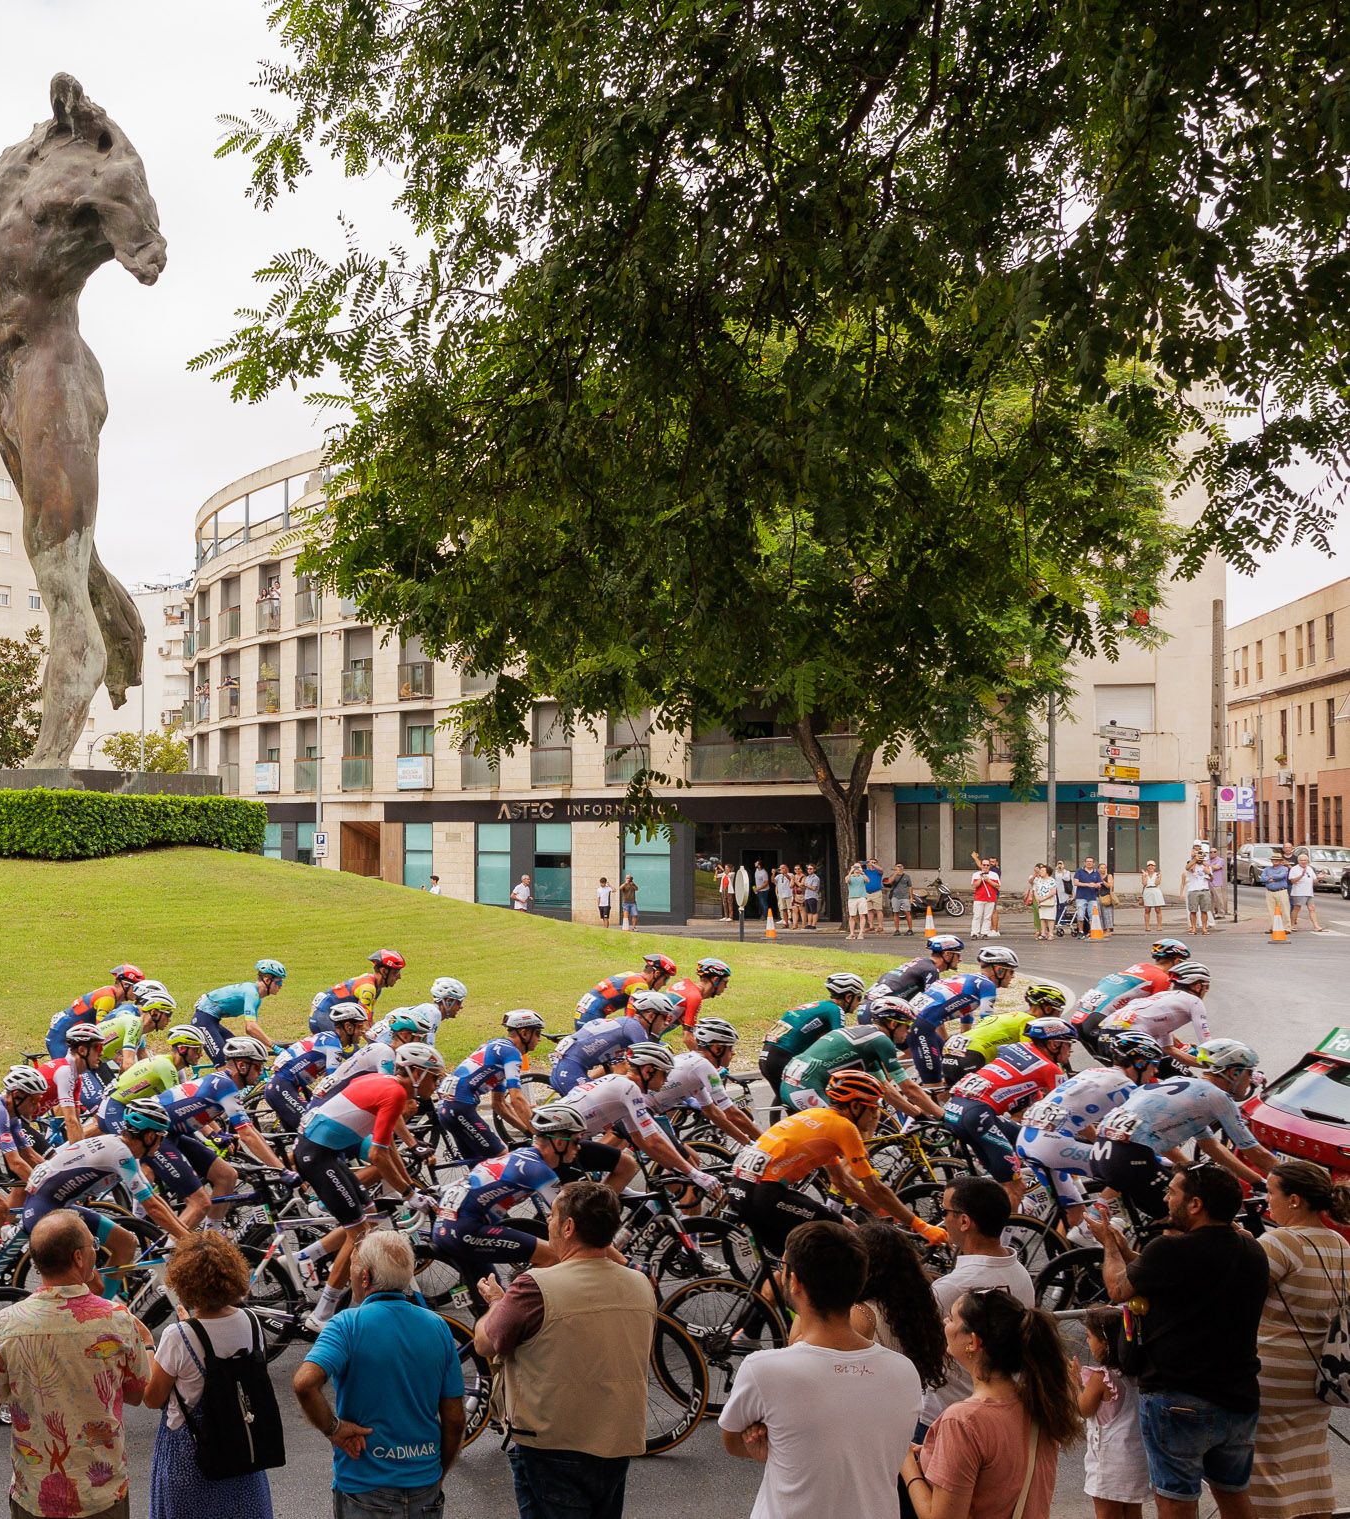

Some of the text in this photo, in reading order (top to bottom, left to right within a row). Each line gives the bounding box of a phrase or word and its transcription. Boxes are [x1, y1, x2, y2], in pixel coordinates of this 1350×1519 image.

[498, 802, 554, 820] ASTEC
[945, 997, 971, 1012] SOUDAL
[199, 1027, 220, 1054] ASTANA
[581, 1038, 607, 1057] Alpecin
[918, 1035, 934, 1070] QUICK-STEP
[469, 1067, 496, 1086] SOUDAL
[1170, 1058, 1192, 1077] UAE
[174, 1101, 205, 1118] SOUDAL
[457, 1114, 490, 1149] QUICK-STEP
[1110, 1113, 1137, 1132] 124
[53, 1171, 98, 1201] BAHRAIN
[325, 1168, 355, 1208] Groupama
[477, 1185, 515, 1206] SOUDAL
[254, 1207, 267, 1219] 103
[776, 1201, 816, 1219] euskaltel
[463, 1234, 520, 1250] QUICK-STEP
[740, 1238, 751, 1256] 218
[453, 1293, 468, 1308] 34
[372, 1442, 436, 1460] CADIMAR
